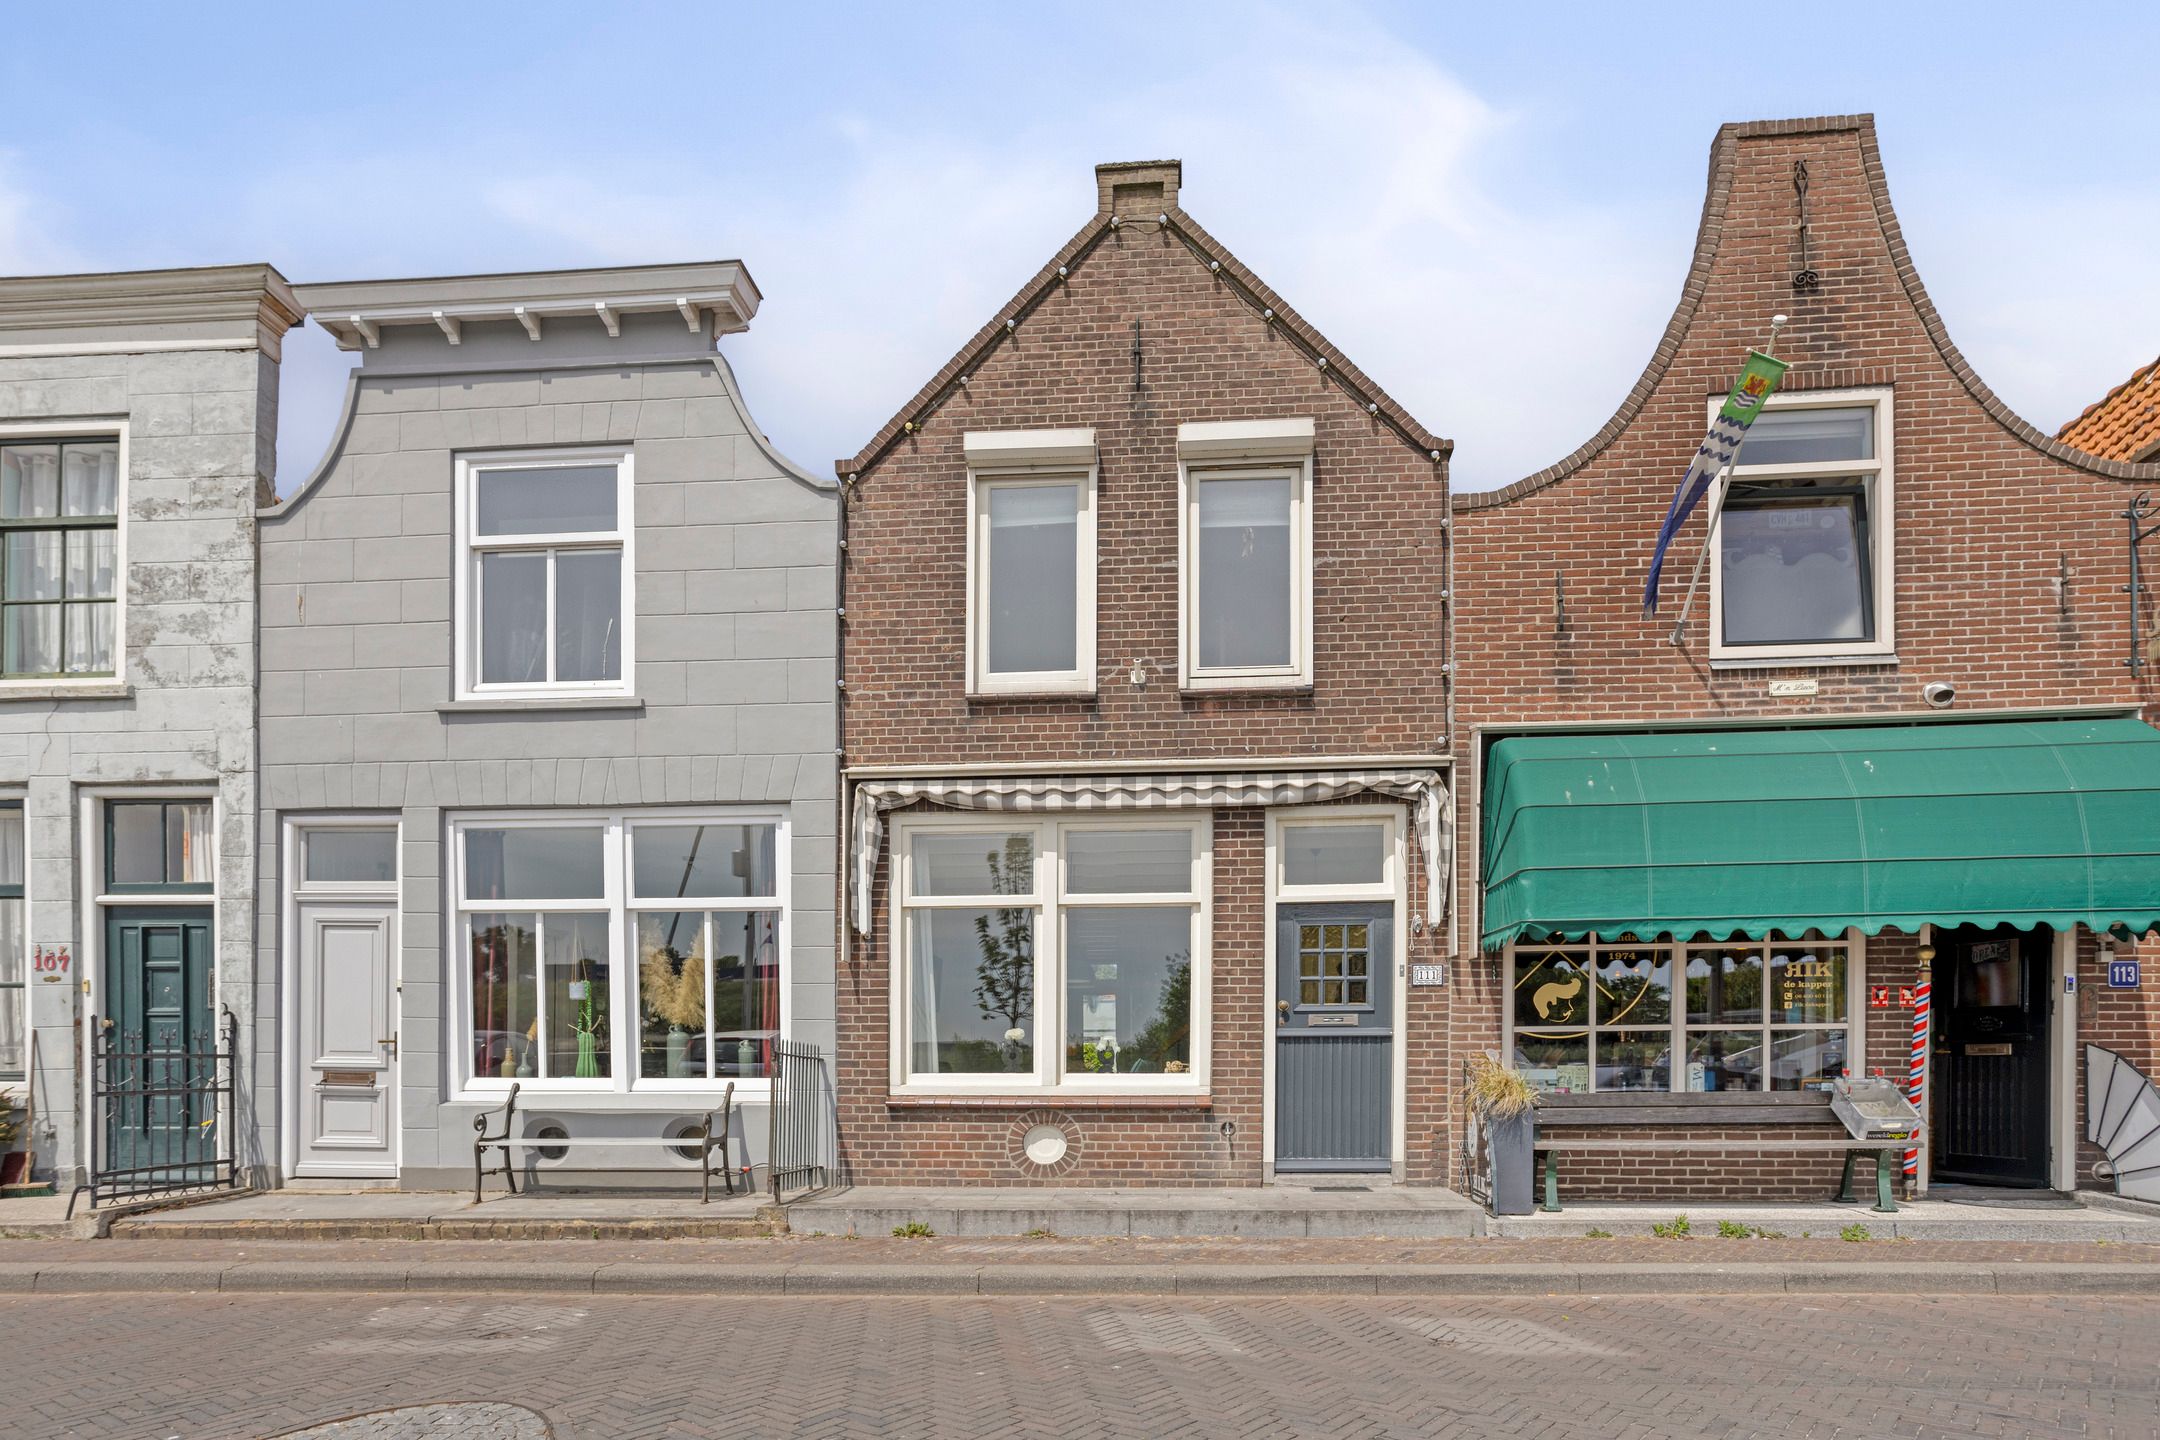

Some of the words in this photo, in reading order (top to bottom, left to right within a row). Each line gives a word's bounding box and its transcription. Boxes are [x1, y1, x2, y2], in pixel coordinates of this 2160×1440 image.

[33, 947, 70, 972] 107
[1608, 952, 1637, 960] 1974
[1419, 970, 1436, 980] 111
[2113, 966, 2136, 982] 113
[1784, 980, 1796, 988] de
[1798, 980, 1833, 990] kapper
